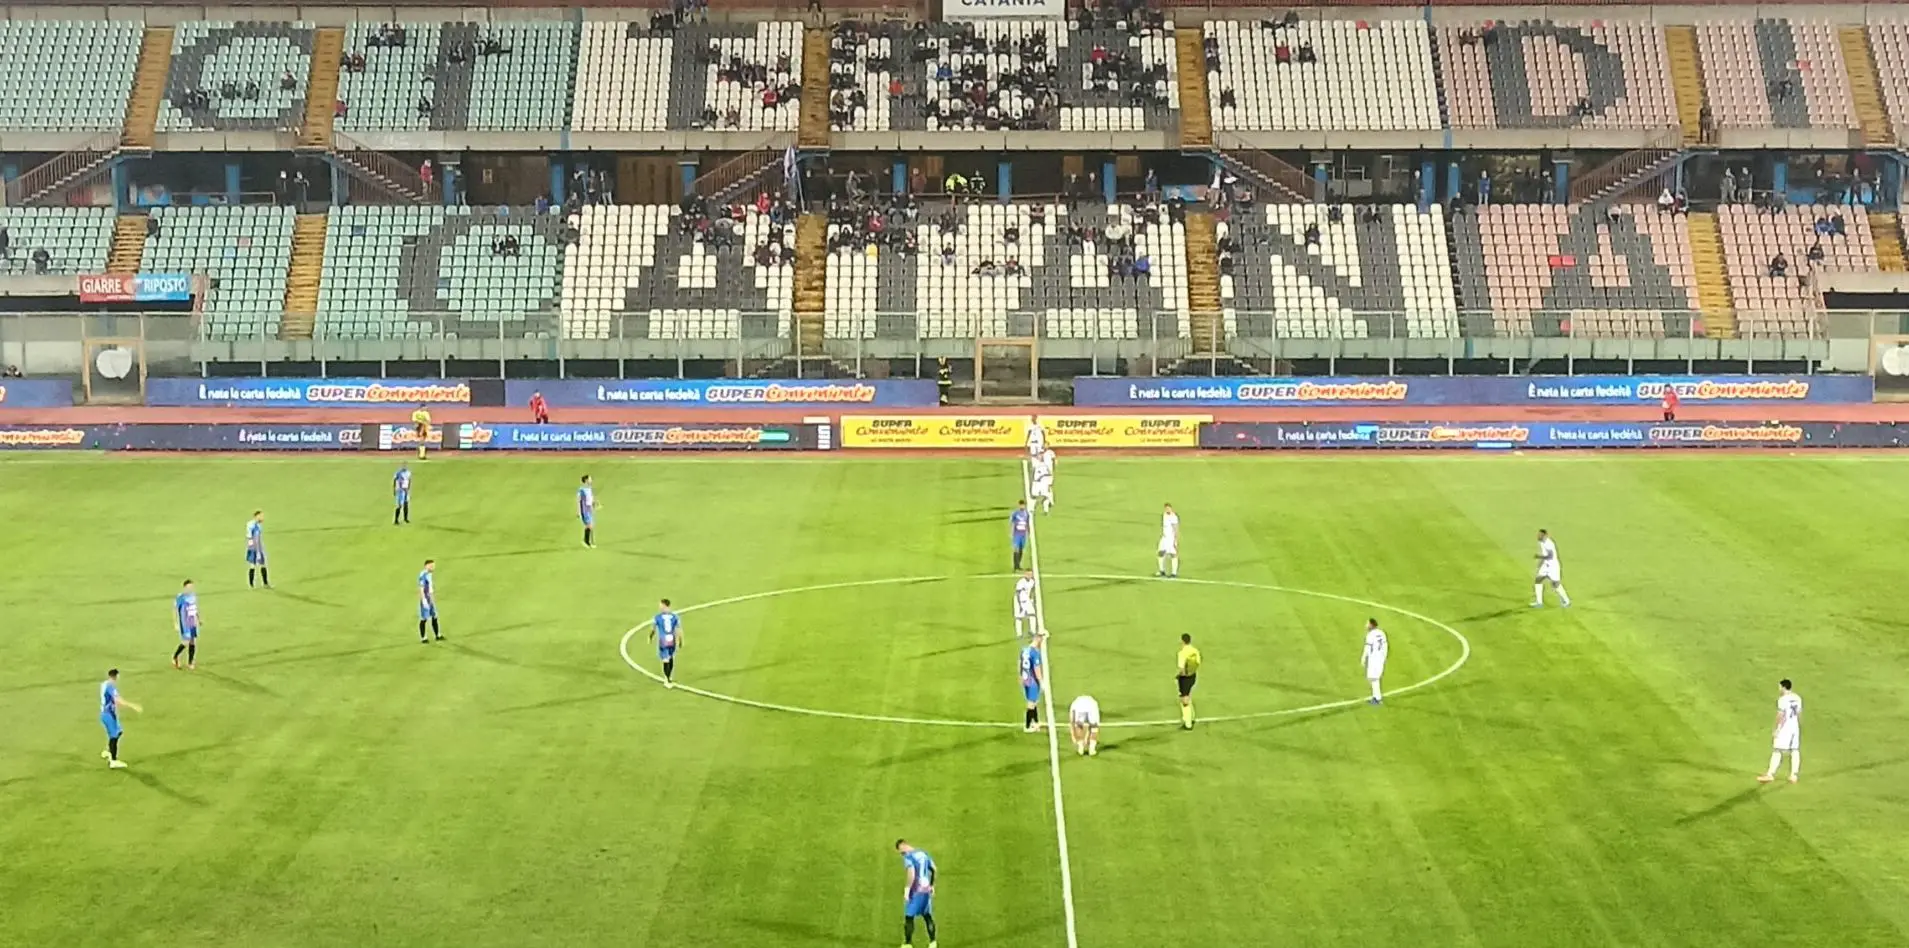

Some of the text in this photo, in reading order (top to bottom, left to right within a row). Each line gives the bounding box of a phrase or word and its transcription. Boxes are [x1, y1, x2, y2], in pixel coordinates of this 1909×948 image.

[82, 279, 187, 293] GIARRE RIPOSTO
[872, 419, 912, 427] SUPER
[955, 419, 996, 427] SUPER
[1057, 419, 1097, 427] SUPER
[1140, 419, 1181, 427] SUPER
